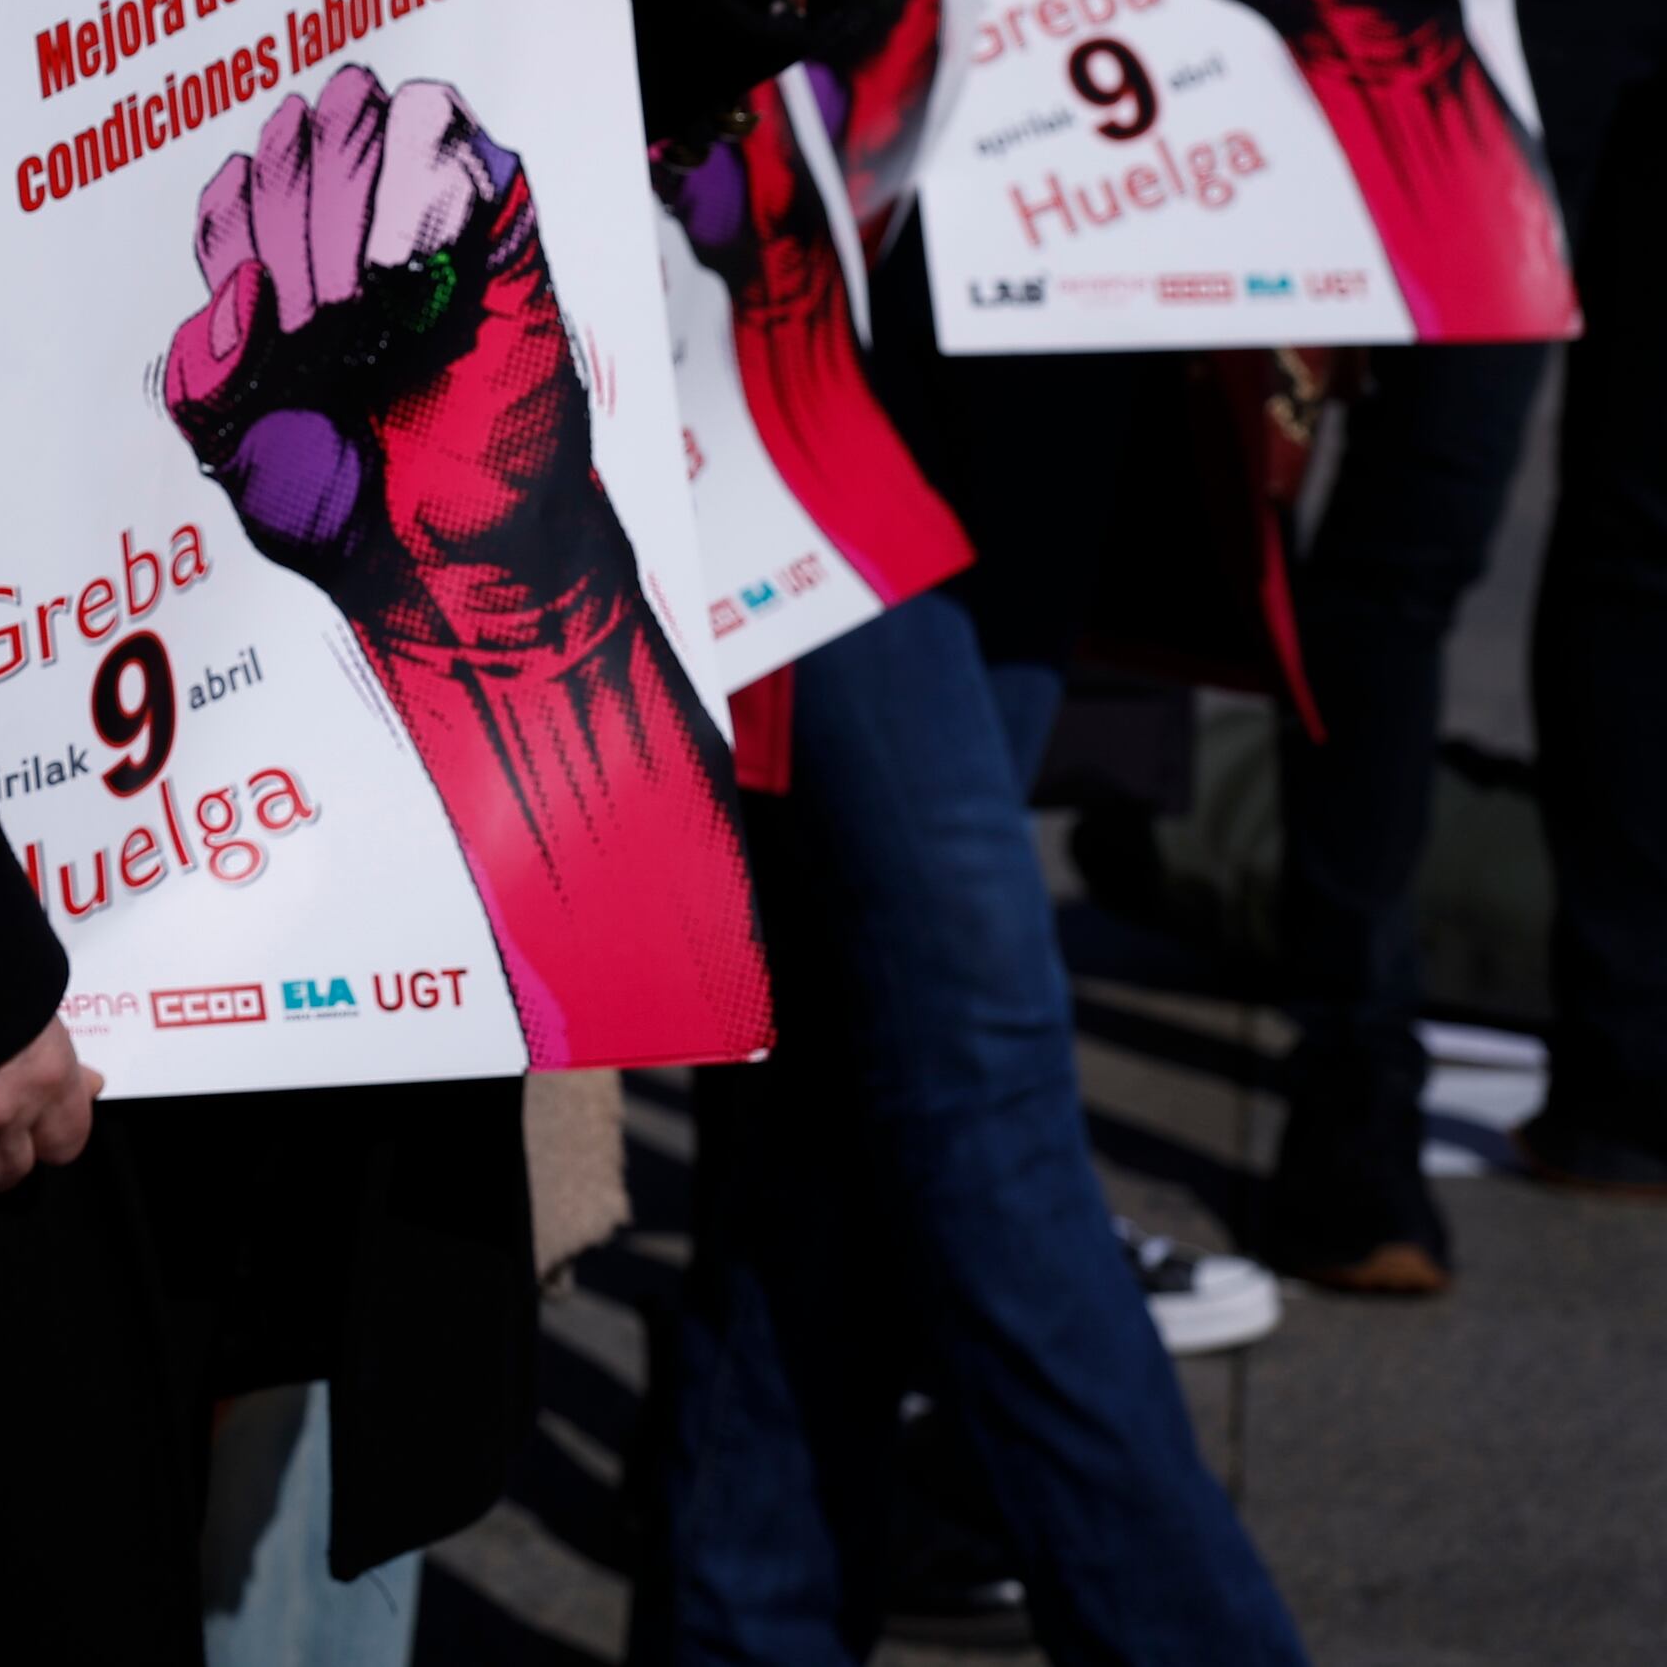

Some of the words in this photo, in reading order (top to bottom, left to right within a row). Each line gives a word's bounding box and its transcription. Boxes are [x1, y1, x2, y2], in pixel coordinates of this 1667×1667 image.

[16, 34, 279, 214] condiciones
[1068, 38, 1159, 142] 9
[1007, 129, 1267, 247] Huelga
[91, 631, 176, 799] 9
[187, 646, 265, 711] abril
[157, 989, 263, 1024] CCOO
[281, 976, 356, 1010] ELA
[373, 968, 468, 1012] UGT
